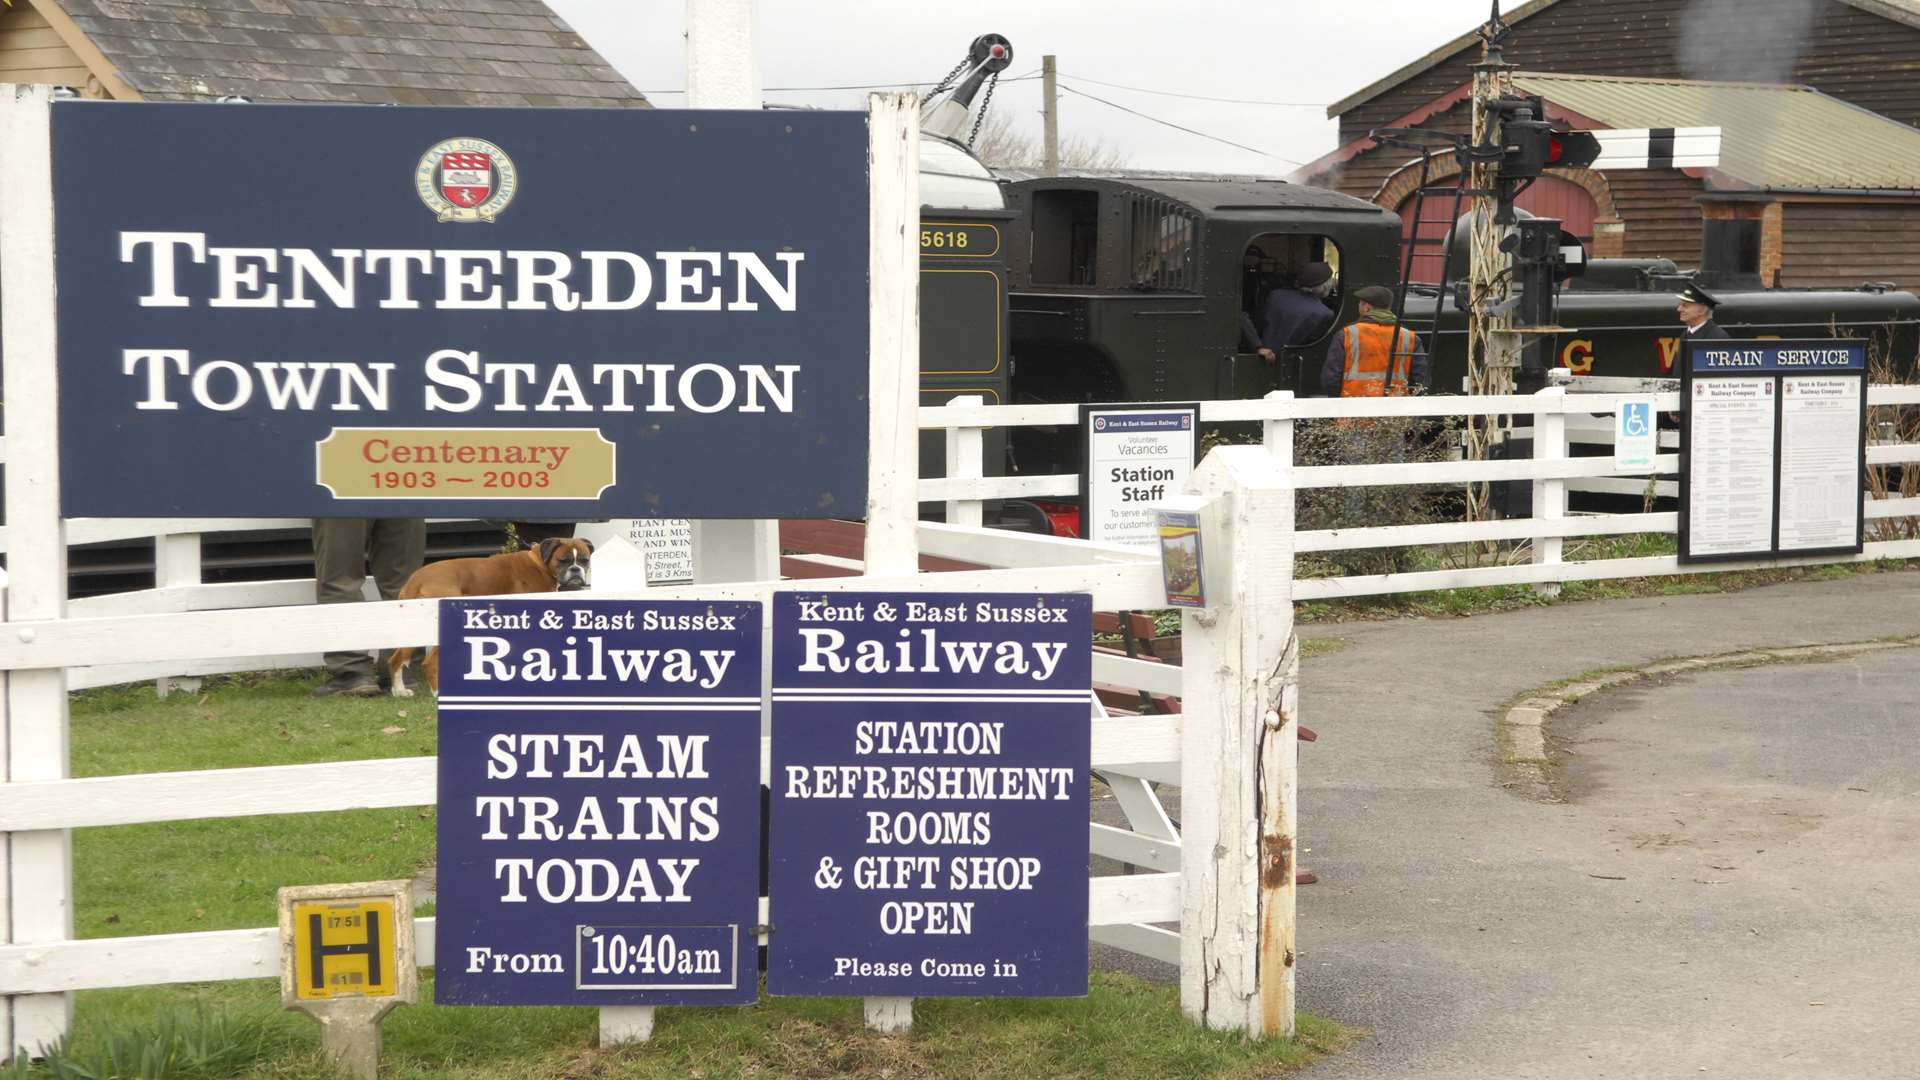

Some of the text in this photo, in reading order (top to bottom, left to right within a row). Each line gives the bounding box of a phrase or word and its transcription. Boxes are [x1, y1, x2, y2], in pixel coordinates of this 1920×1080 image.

[921, 231, 968, 248] 5618
[120, 231, 804, 311] TENTERDEN
[1560, 339, 1594, 373] G
[1706, 350, 1849, 366] TRAIN SERVICE
[123, 349, 800, 413] TOWN STATION
[362, 439, 570, 471] Centenary
[1118, 444, 1168, 455] Vacancies
[371, 472, 436, 488] 1903
[483, 471, 550, 488] 2003
[1111, 466, 1174, 483] Station
[1122, 485, 1164, 502] Staff
[1110, 509, 1119, 517] To
[630, 530, 666, 538] RURAL
[643, 540, 667, 548] AND
[665, 570, 671, 578] 3
[464, 610, 735, 630] Kent & East Sussex
[799, 602, 1067, 623] Kent & East Sussex
[464, 637, 735, 688] Railway
[799, 629, 1067, 680] Railway
[856, 721, 1004, 755] STATION
[488, 734, 709, 779] STEAM
[785, 766, 1073, 800] REFRESHMENT
[476, 797, 719, 841] TRAINS
[866, 812, 990, 845] ROOMS
[496, 859, 699, 903] TODAY
[815, 856, 1040, 890] & GIFT SHOP
[880, 902, 974, 934] OPEN
[309, 911, 381, 988] H
[466, 934, 722, 974] From 10:40am
[835, 958, 1018, 977] Please Come in
